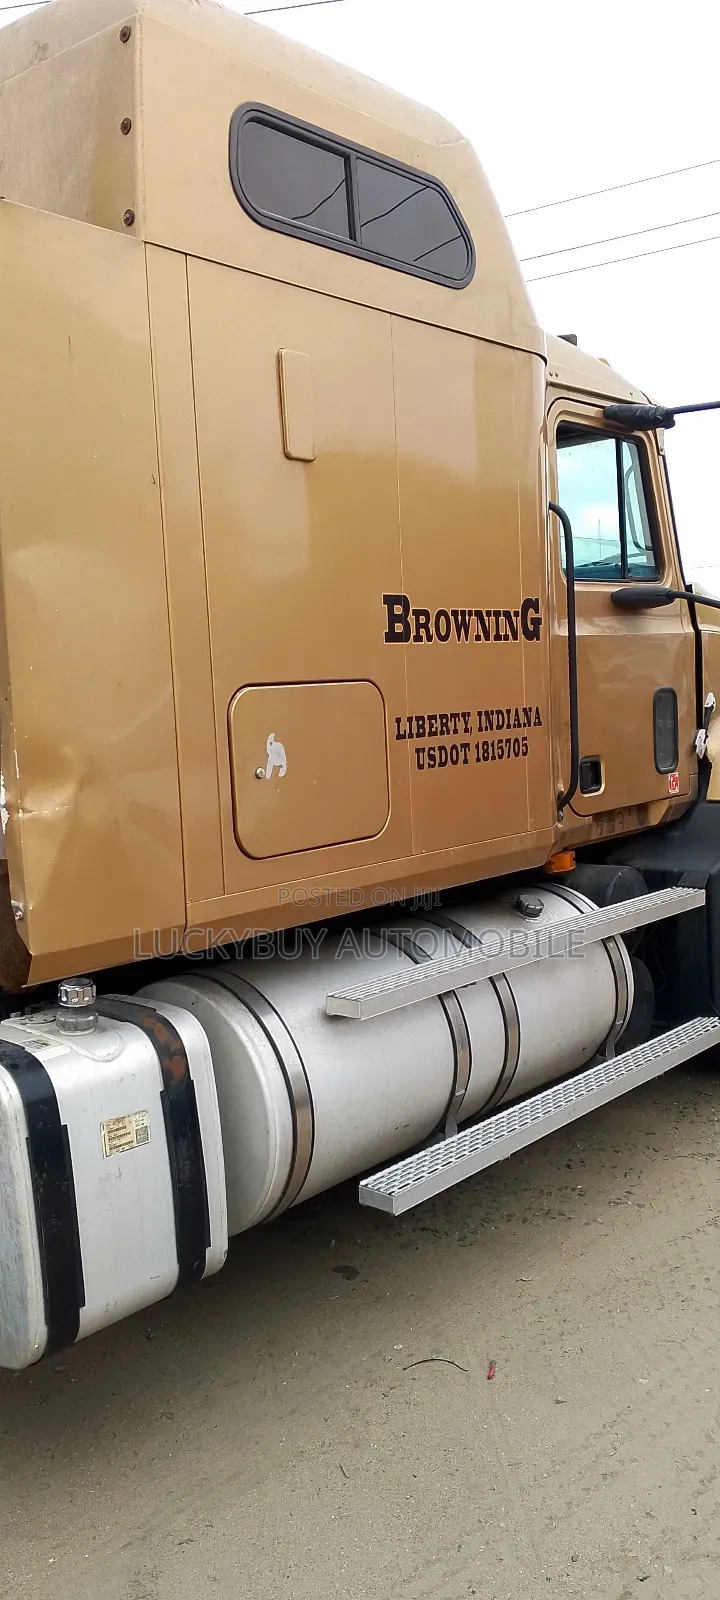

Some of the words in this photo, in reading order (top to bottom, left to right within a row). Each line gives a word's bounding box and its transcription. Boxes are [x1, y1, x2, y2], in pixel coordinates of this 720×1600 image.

[382, 593, 543, 644] BROWNING
[395, 711, 473, 741] LIBERTY,
[477, 706, 543, 733] INDIANA
[415, 742, 471, 771] USDOT
[474, 736, 529, 763] 1815705
